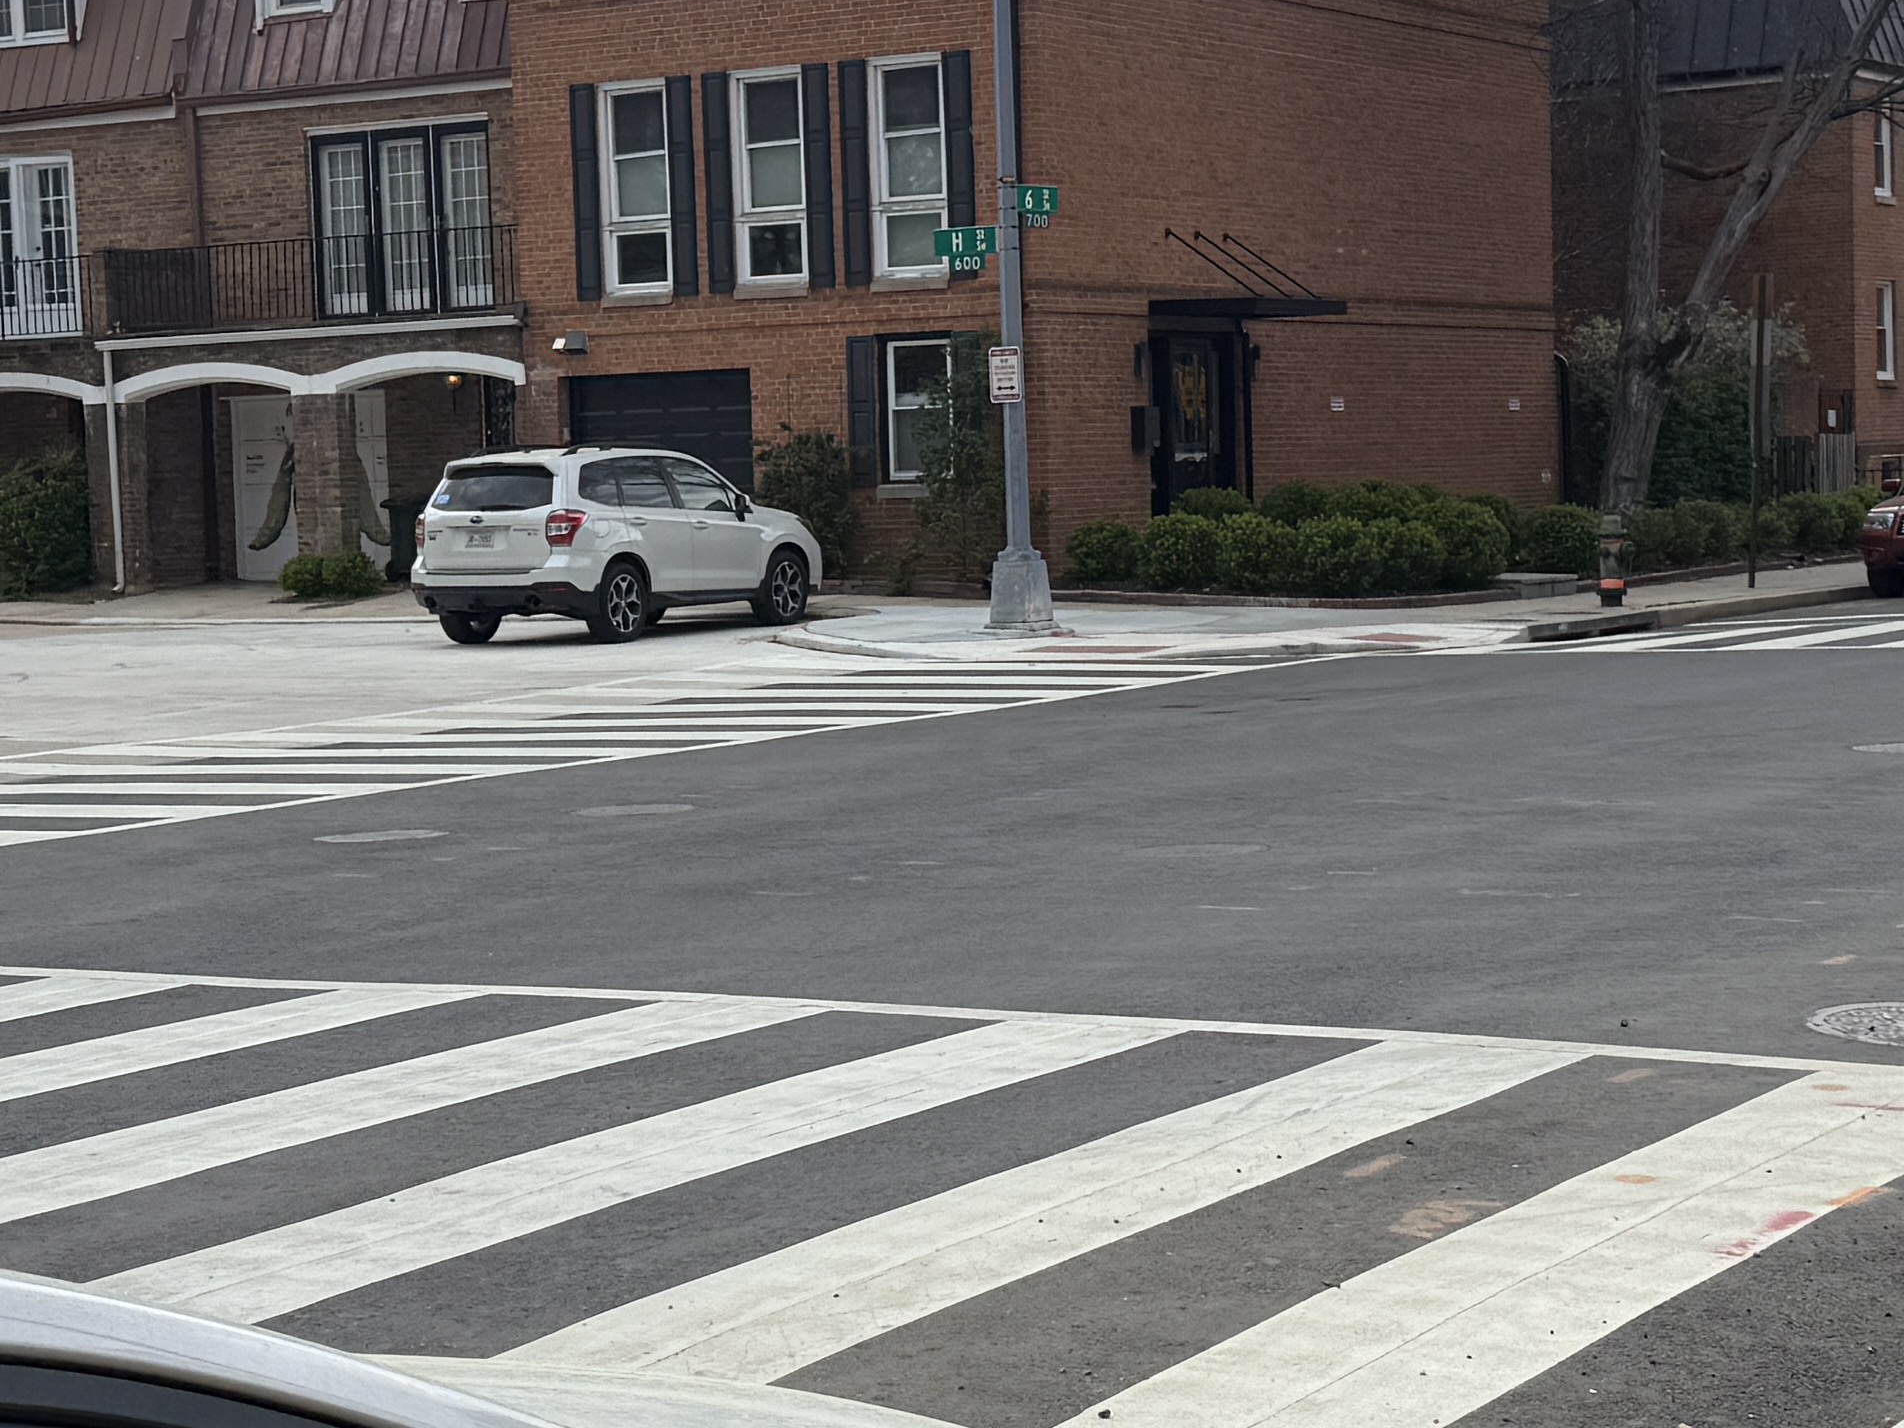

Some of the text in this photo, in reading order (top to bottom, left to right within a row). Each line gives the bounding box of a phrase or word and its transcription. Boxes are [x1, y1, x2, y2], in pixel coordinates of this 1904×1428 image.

[1024, 189, 1033, 210] 6
[1026, 213, 1049, 228] 700
[951, 231, 963, 253] H
[954, 256, 981, 271] 600
